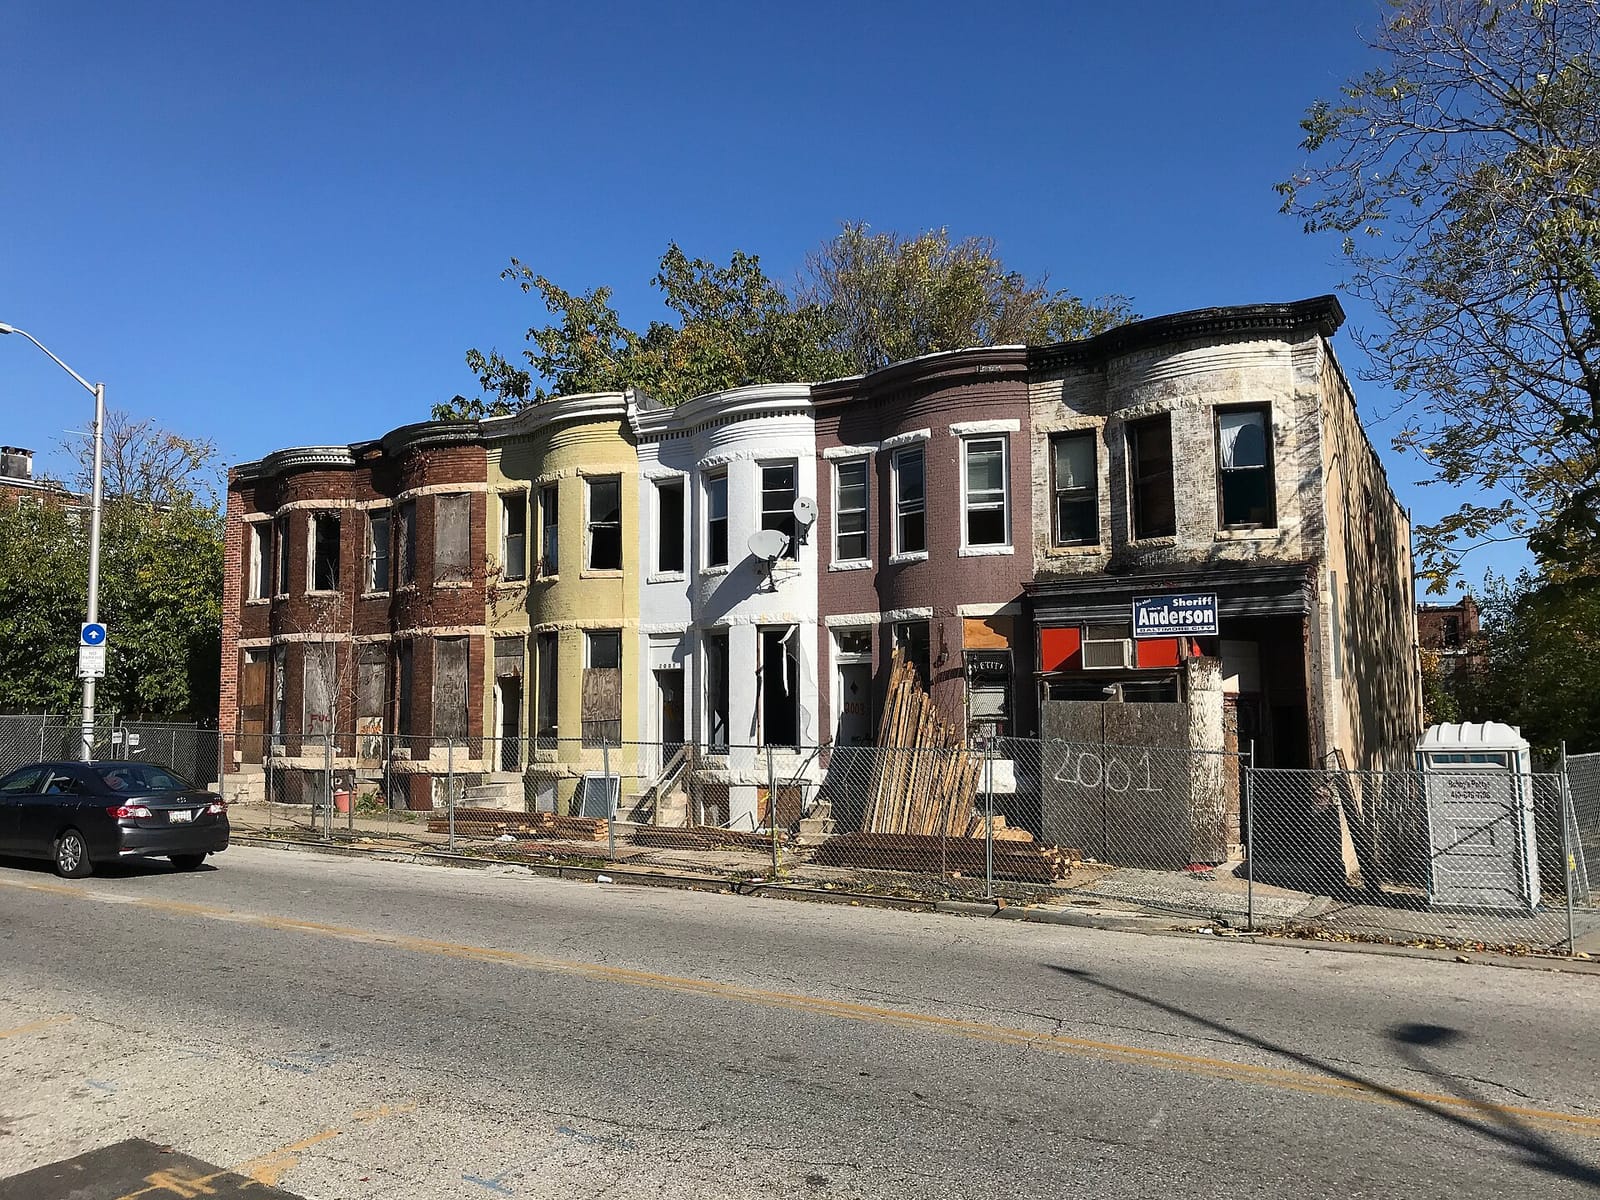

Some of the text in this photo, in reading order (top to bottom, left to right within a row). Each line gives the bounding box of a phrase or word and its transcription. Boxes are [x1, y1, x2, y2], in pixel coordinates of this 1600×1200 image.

[1172, 597, 1212, 606] Sheriff
[1138, 605, 1214, 625] Anderson
[1055, 738, 1162, 792] 2001
